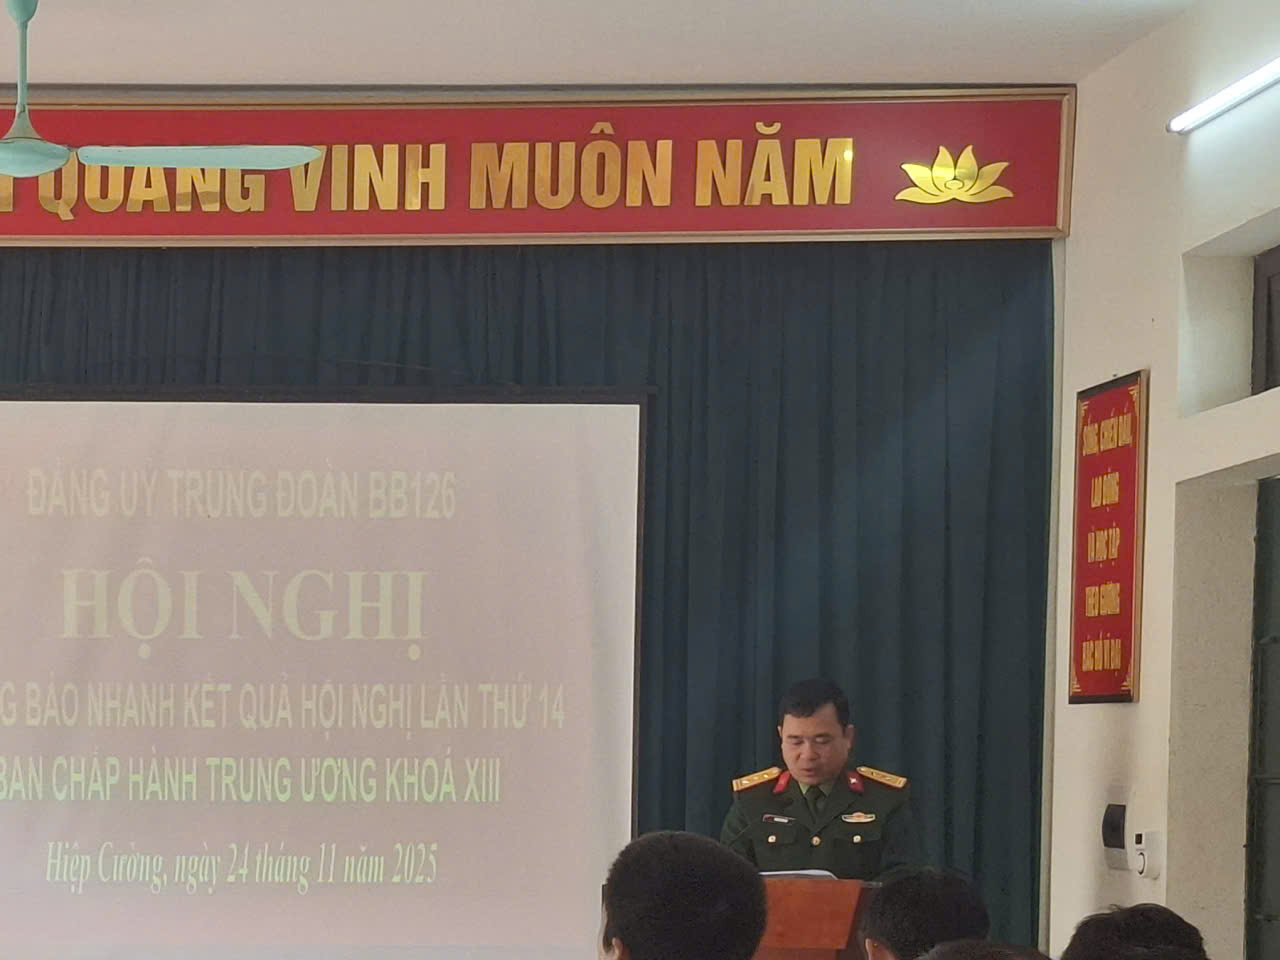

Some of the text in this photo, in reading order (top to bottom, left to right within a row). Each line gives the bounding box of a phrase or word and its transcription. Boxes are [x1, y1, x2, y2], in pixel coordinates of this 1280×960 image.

[37, 148, 266, 221] QUANG
[289, 143, 446, 212] VINH
[469, 121, 672, 210] MUÔN
[695, 121, 853, 207] NĂM
[167, 468, 269, 519] TRUNG
[275, 457, 360, 519] ĐOÀN
[369, 469, 457, 520] BB126
[59, 556, 429, 661] HỘI NGHỊ
[87, 682, 175, 728] NHANH
[239, 671, 293, 730] QUẢ
[301, 678, 343, 741] HỘI
[351, 683, 414, 741] NGHỊ
[539, 683, 565, 729] 14
[127, 745, 198, 802] HÀNH
[205, 756, 292, 803] TRUNG
[300, 757, 377, 803] ƯƠNG
[385, 747, 457, 803] KHOÁ
[463, 757, 502, 803] XIII
[45, 841, 91, 895] Hiệp
[174, 841, 221, 895] ngày
[226, 841, 250, 883] 24
[254, 841, 311, 896] tháng
[317, 842, 338, 883] 11
[343, 842, 385, 883] năm
[391, 842, 439, 884] 2025
